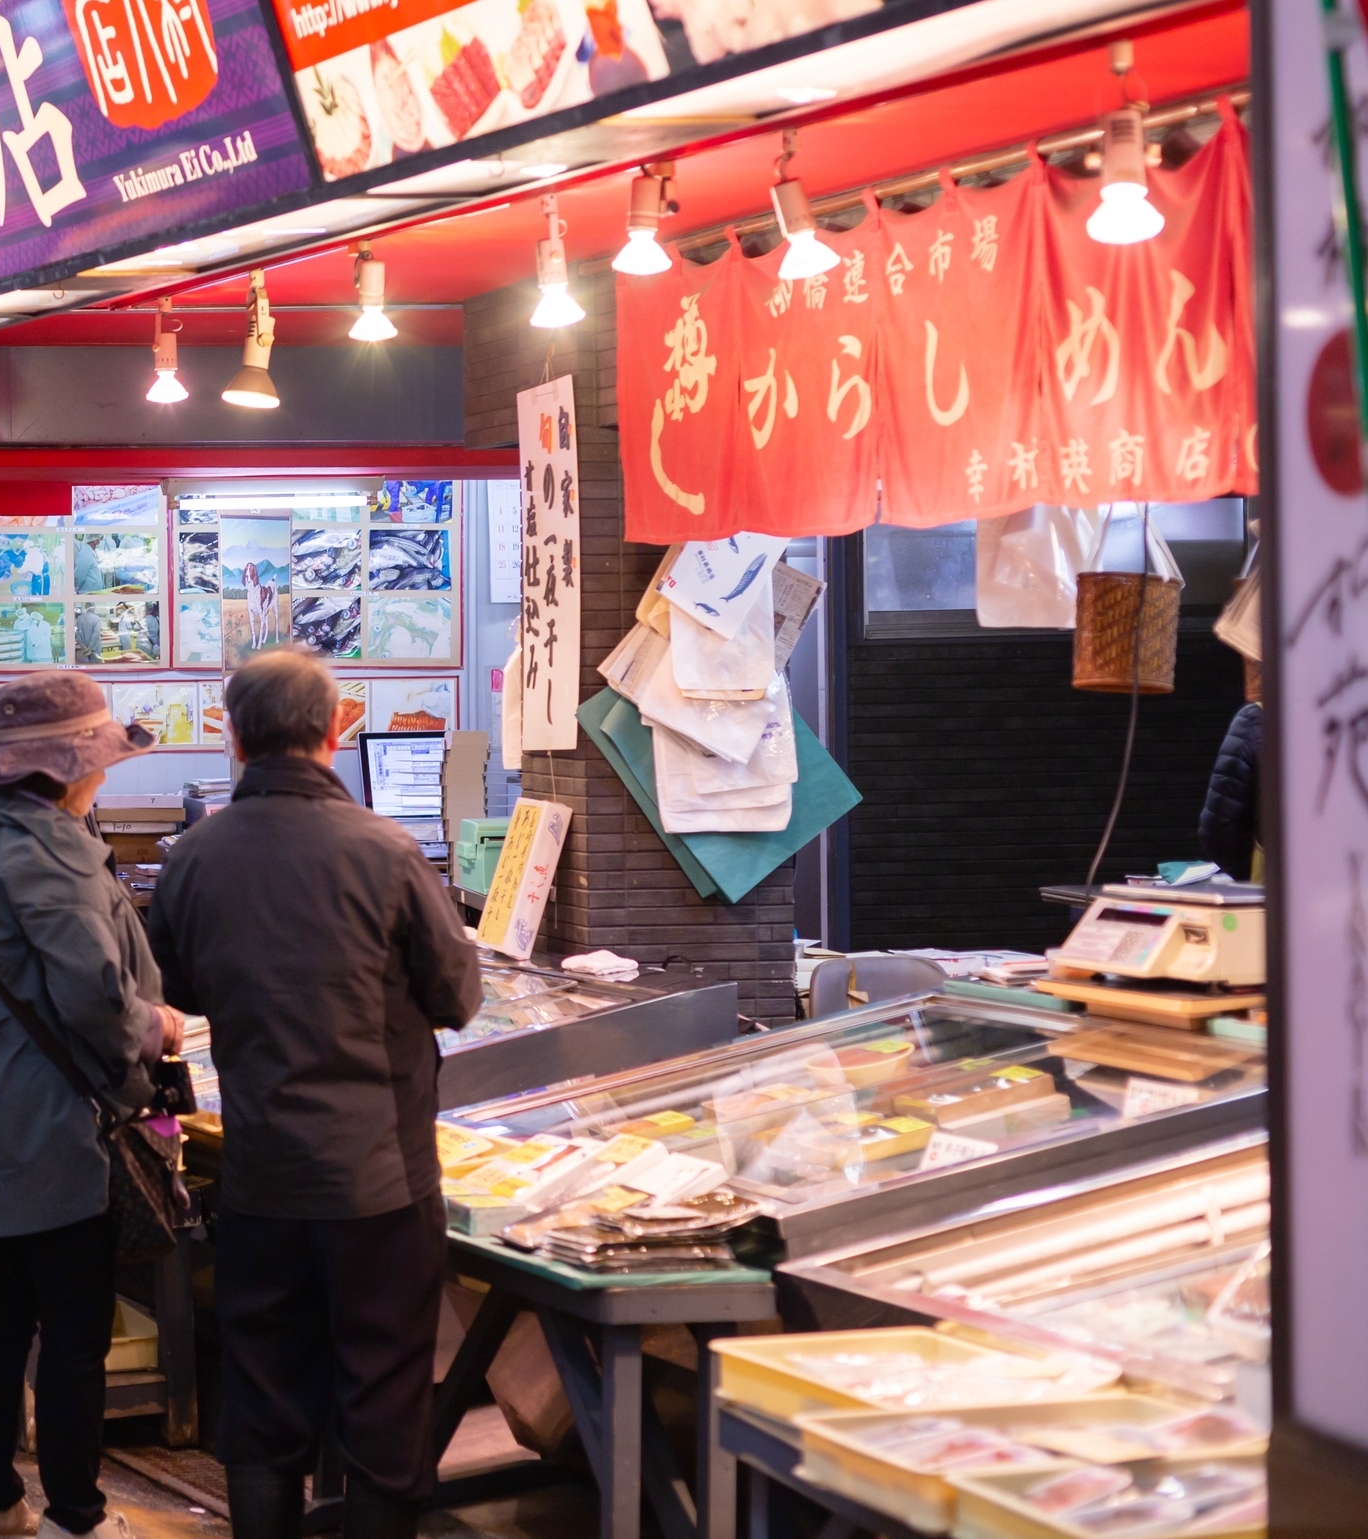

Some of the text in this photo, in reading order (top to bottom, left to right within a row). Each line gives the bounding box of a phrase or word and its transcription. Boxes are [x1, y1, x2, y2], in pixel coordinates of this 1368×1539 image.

[113, 164, 184, 202] Yukimura
[179, 149, 203, 182] Ei
[512, 525, 519, 533] 12
[512, 543, 520, 551] 19
[498, 561, 507, 569] 25
